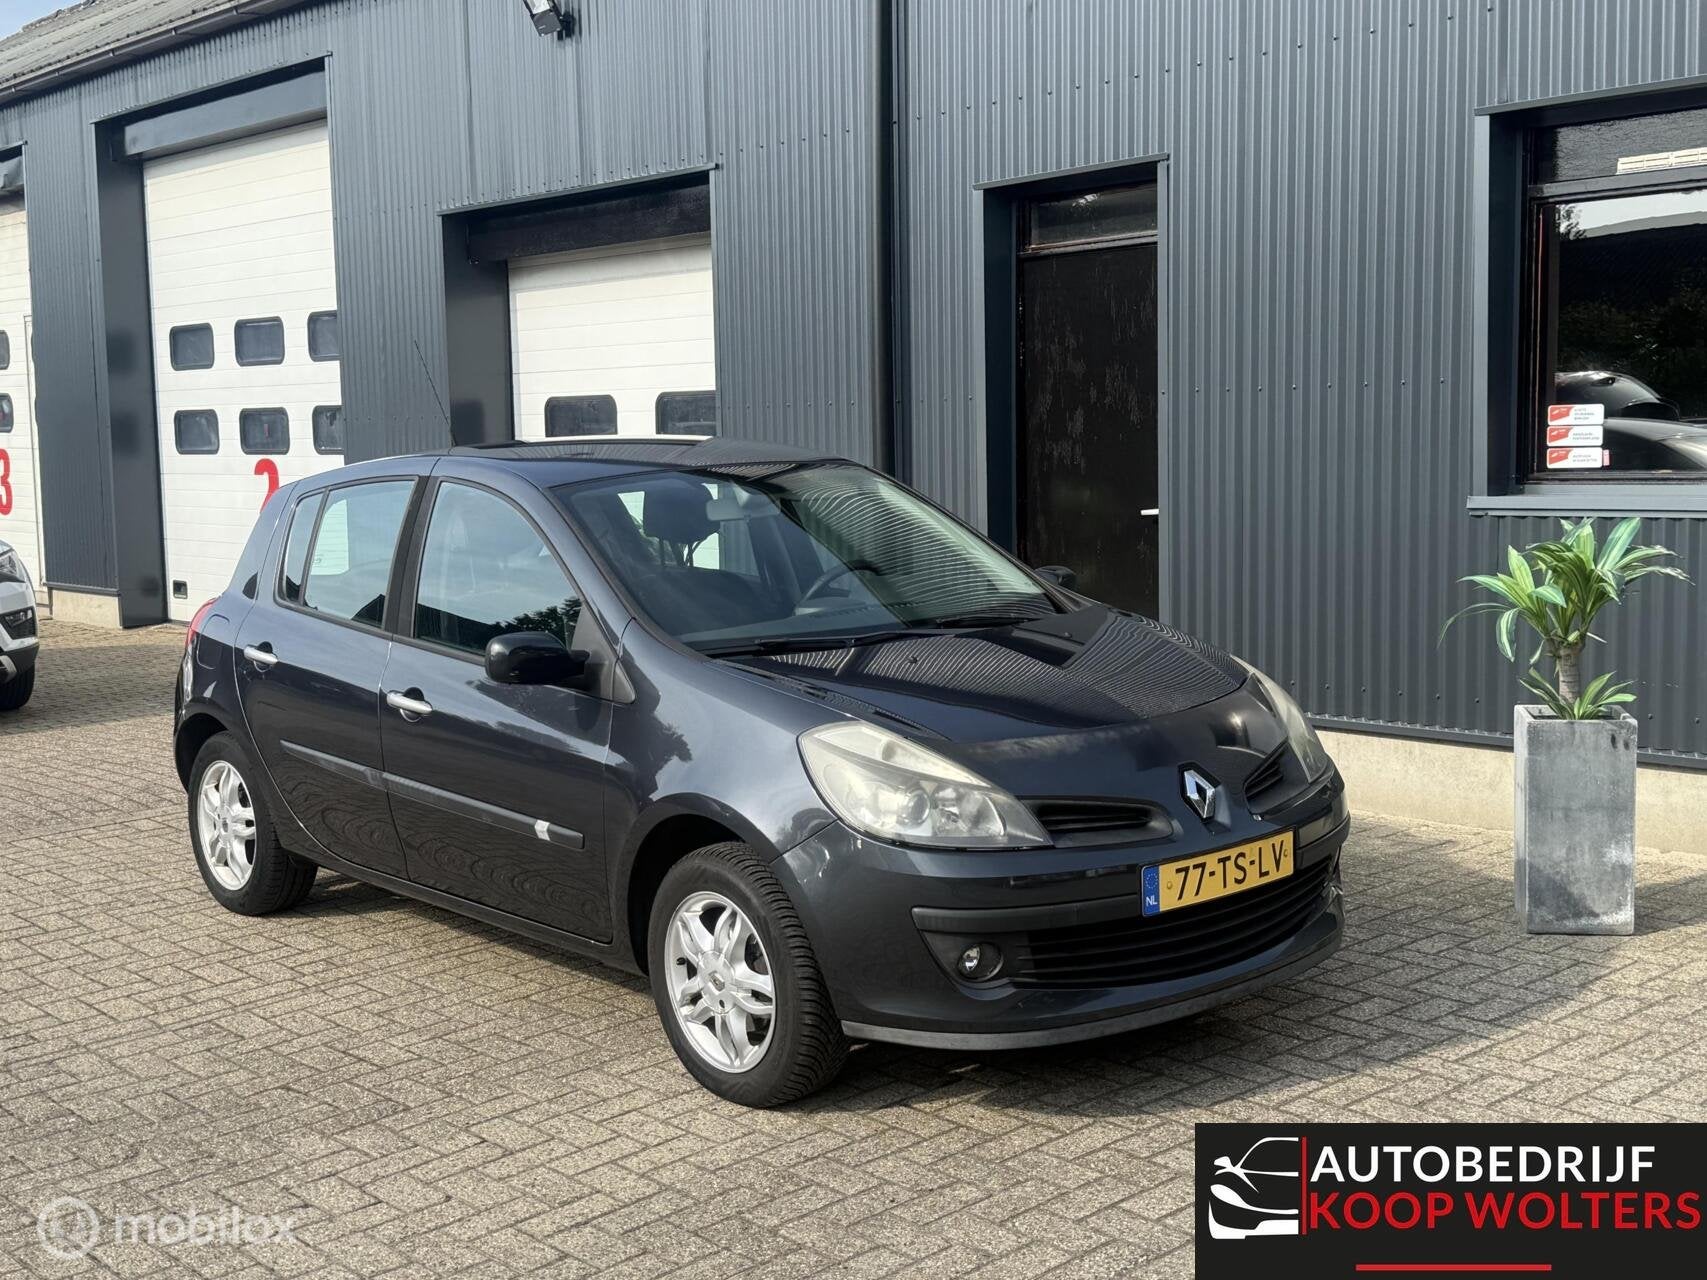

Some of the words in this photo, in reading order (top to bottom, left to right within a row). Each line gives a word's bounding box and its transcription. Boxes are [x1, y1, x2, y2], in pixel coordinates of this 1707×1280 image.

[0, 448, 13, 515] 3
[254, 458, 280, 513] 2
[1146, 894, 1158, 907] NL
[1175, 840, 1284, 901] 77-TS-LV
